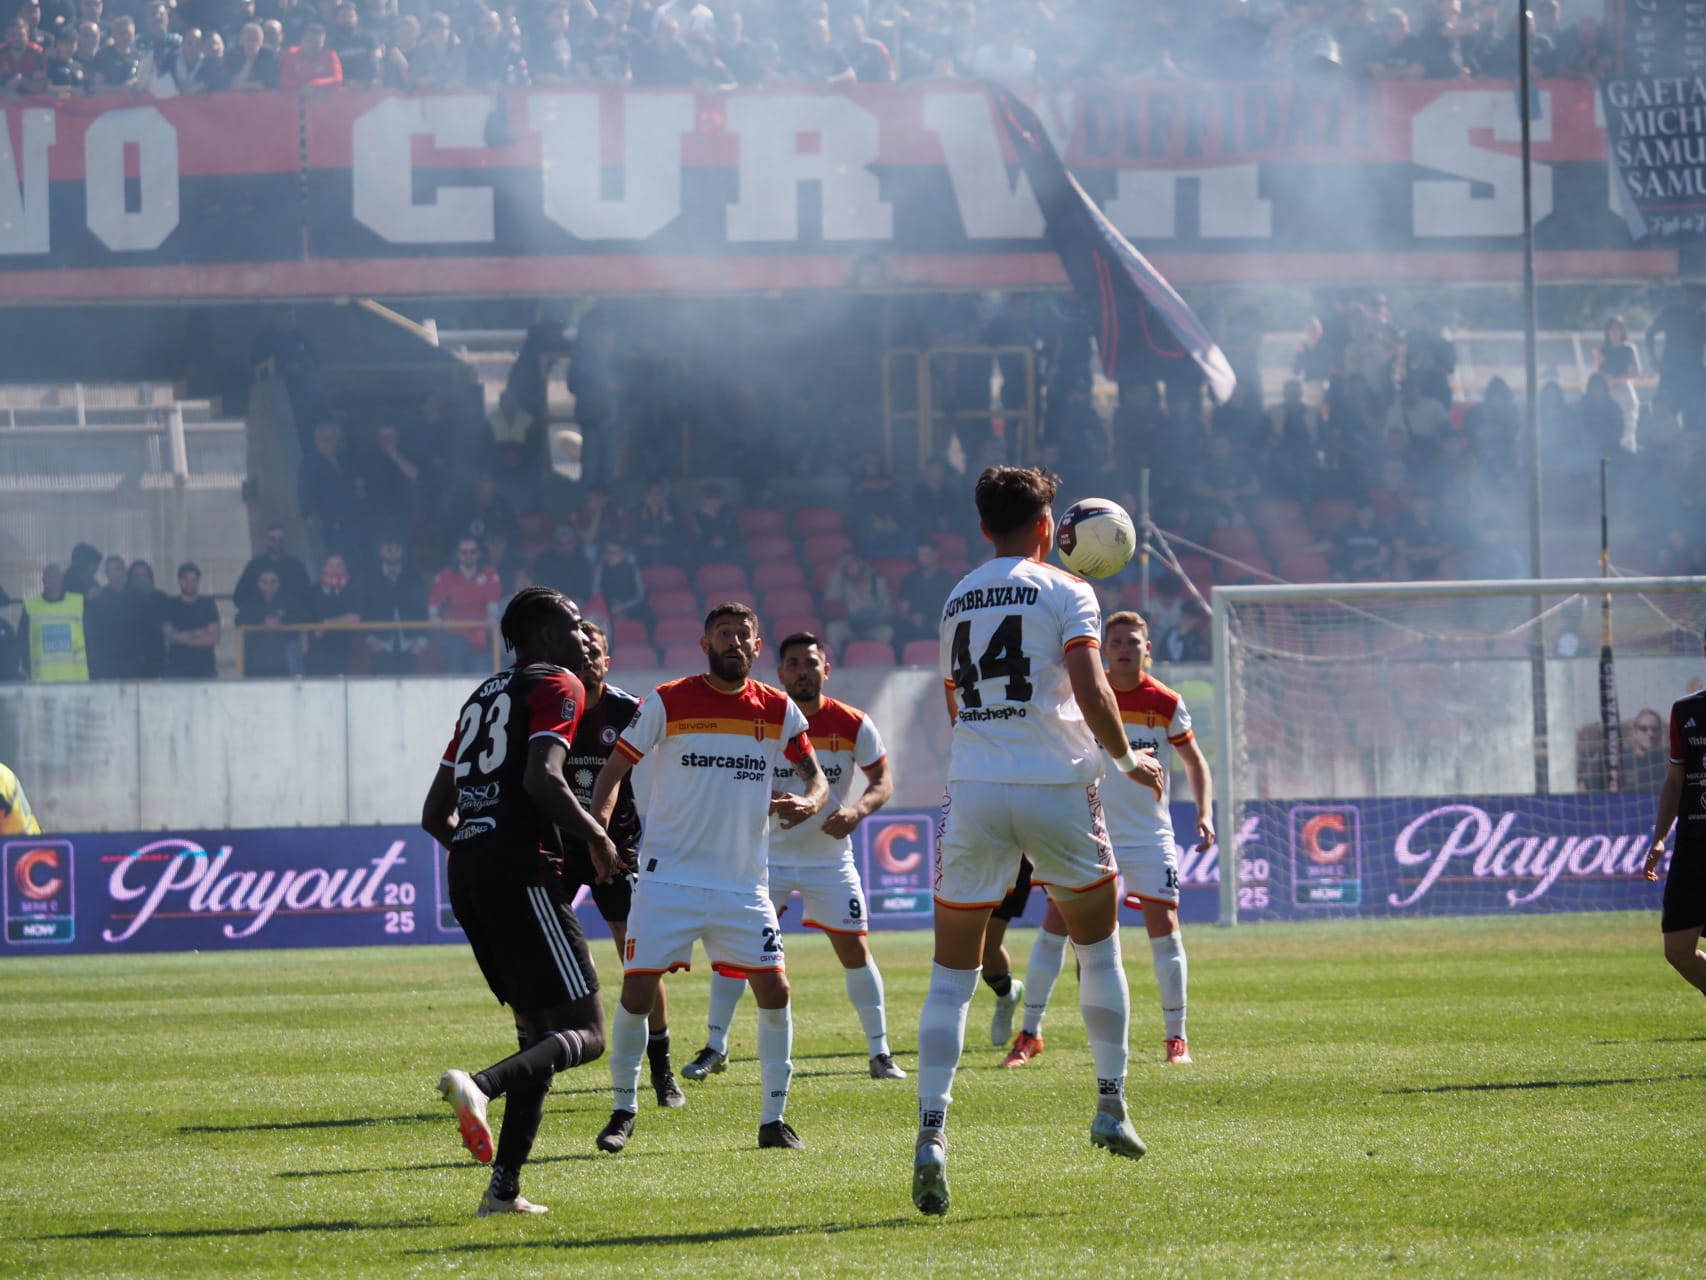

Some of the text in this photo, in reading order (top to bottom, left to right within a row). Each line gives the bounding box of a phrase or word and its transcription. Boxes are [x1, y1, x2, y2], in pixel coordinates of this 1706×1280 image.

[1620, 106, 1706, 138] MICH
[943, 586, 1038, 621] UMBRAVANU
[952, 614, 1033, 708] 44
[454, 692, 512, 778] 23
[679, 721, 717, 730] GIVOVA
[681, 752, 766, 770] starcasinò
[873, 823, 923, 873] C
[1302, 814, 1348, 864] C
[15, 848, 63, 899] C
[1240, 858, 1270, 881] 20
[102, 839, 406, 943] Playout
[385, 883, 415, 905] 20
[1240, 886, 1270, 908] 25
[385, 911, 415, 933] 25
[849, 898, 861, 919] 9
